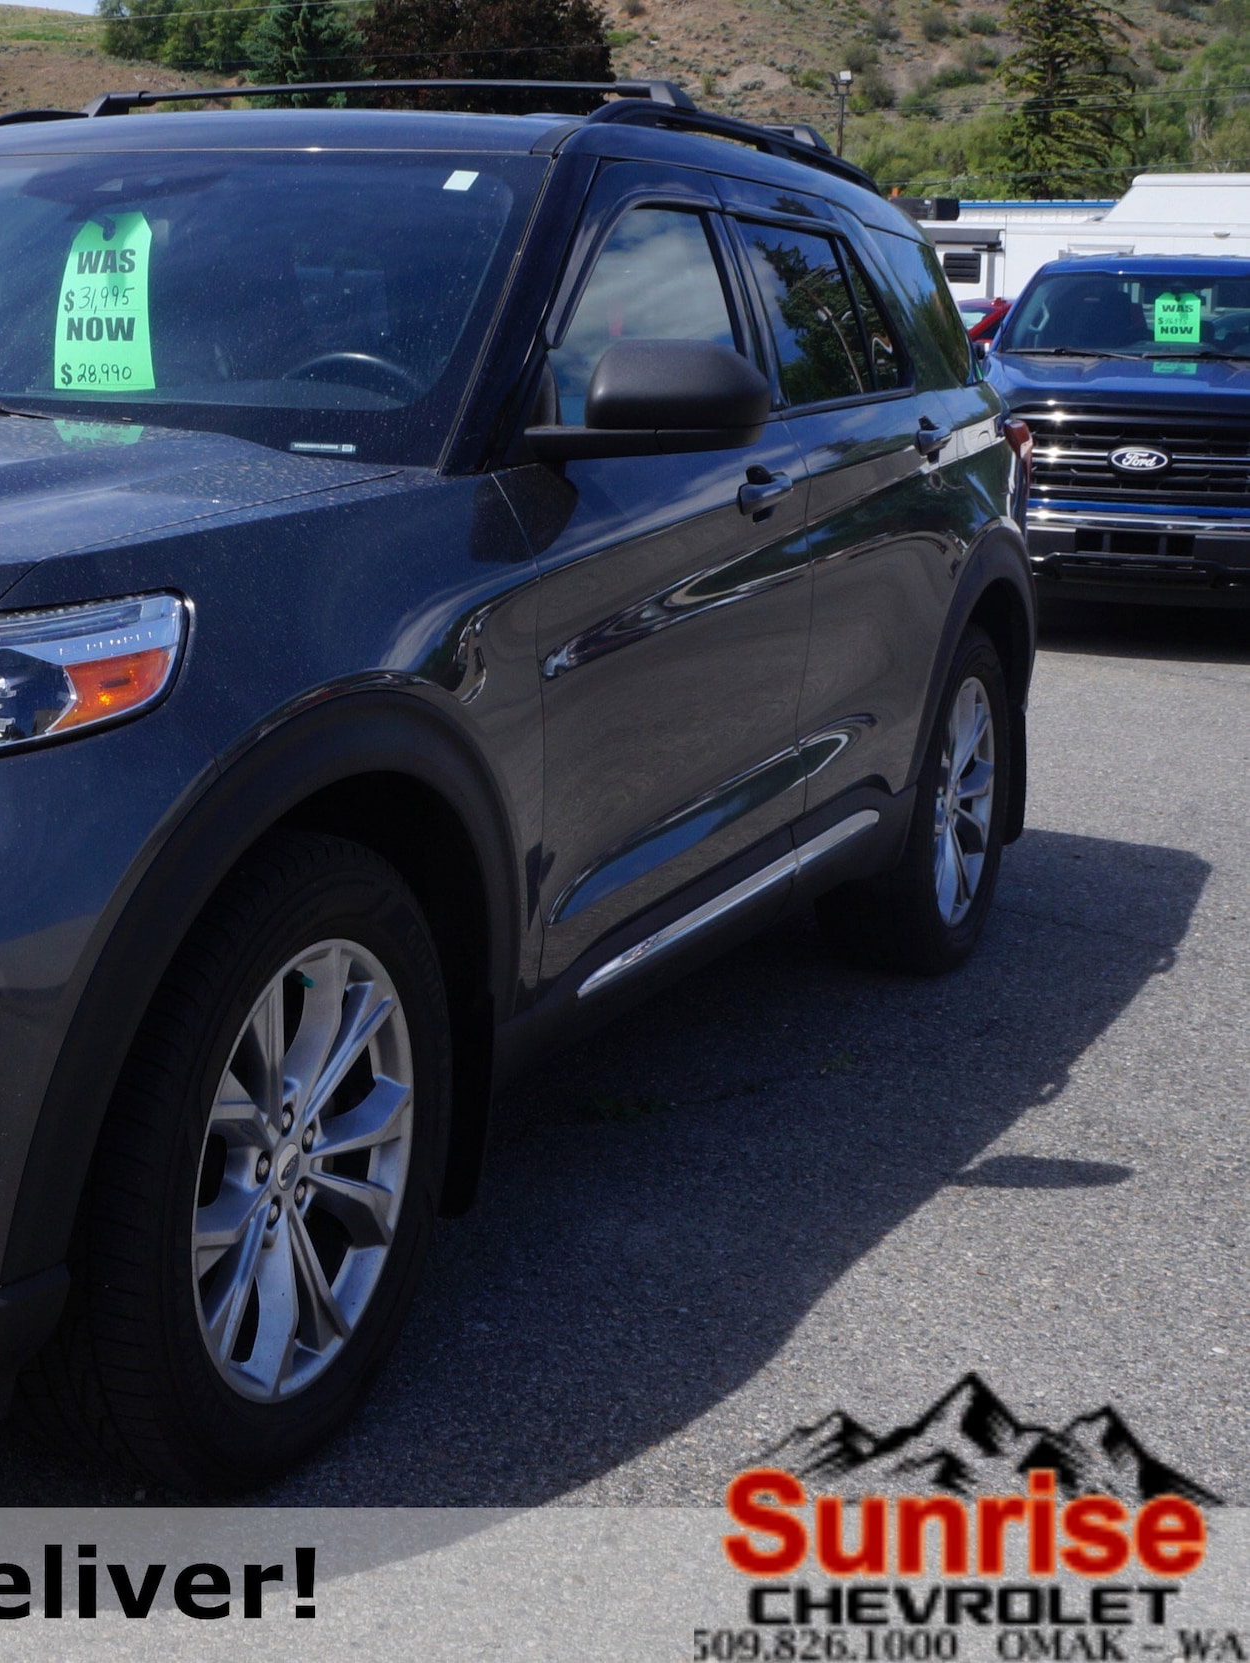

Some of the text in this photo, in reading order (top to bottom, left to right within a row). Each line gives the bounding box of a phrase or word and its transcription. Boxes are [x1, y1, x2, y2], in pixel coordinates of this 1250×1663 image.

[77, 249, 136, 275] WAS
[1162, 304, 1194, 312] WAS
[66, 316, 136, 342] NOW
[1160, 326, 1194, 335] NOW
[1121, 451, 1158, 467] Ford
